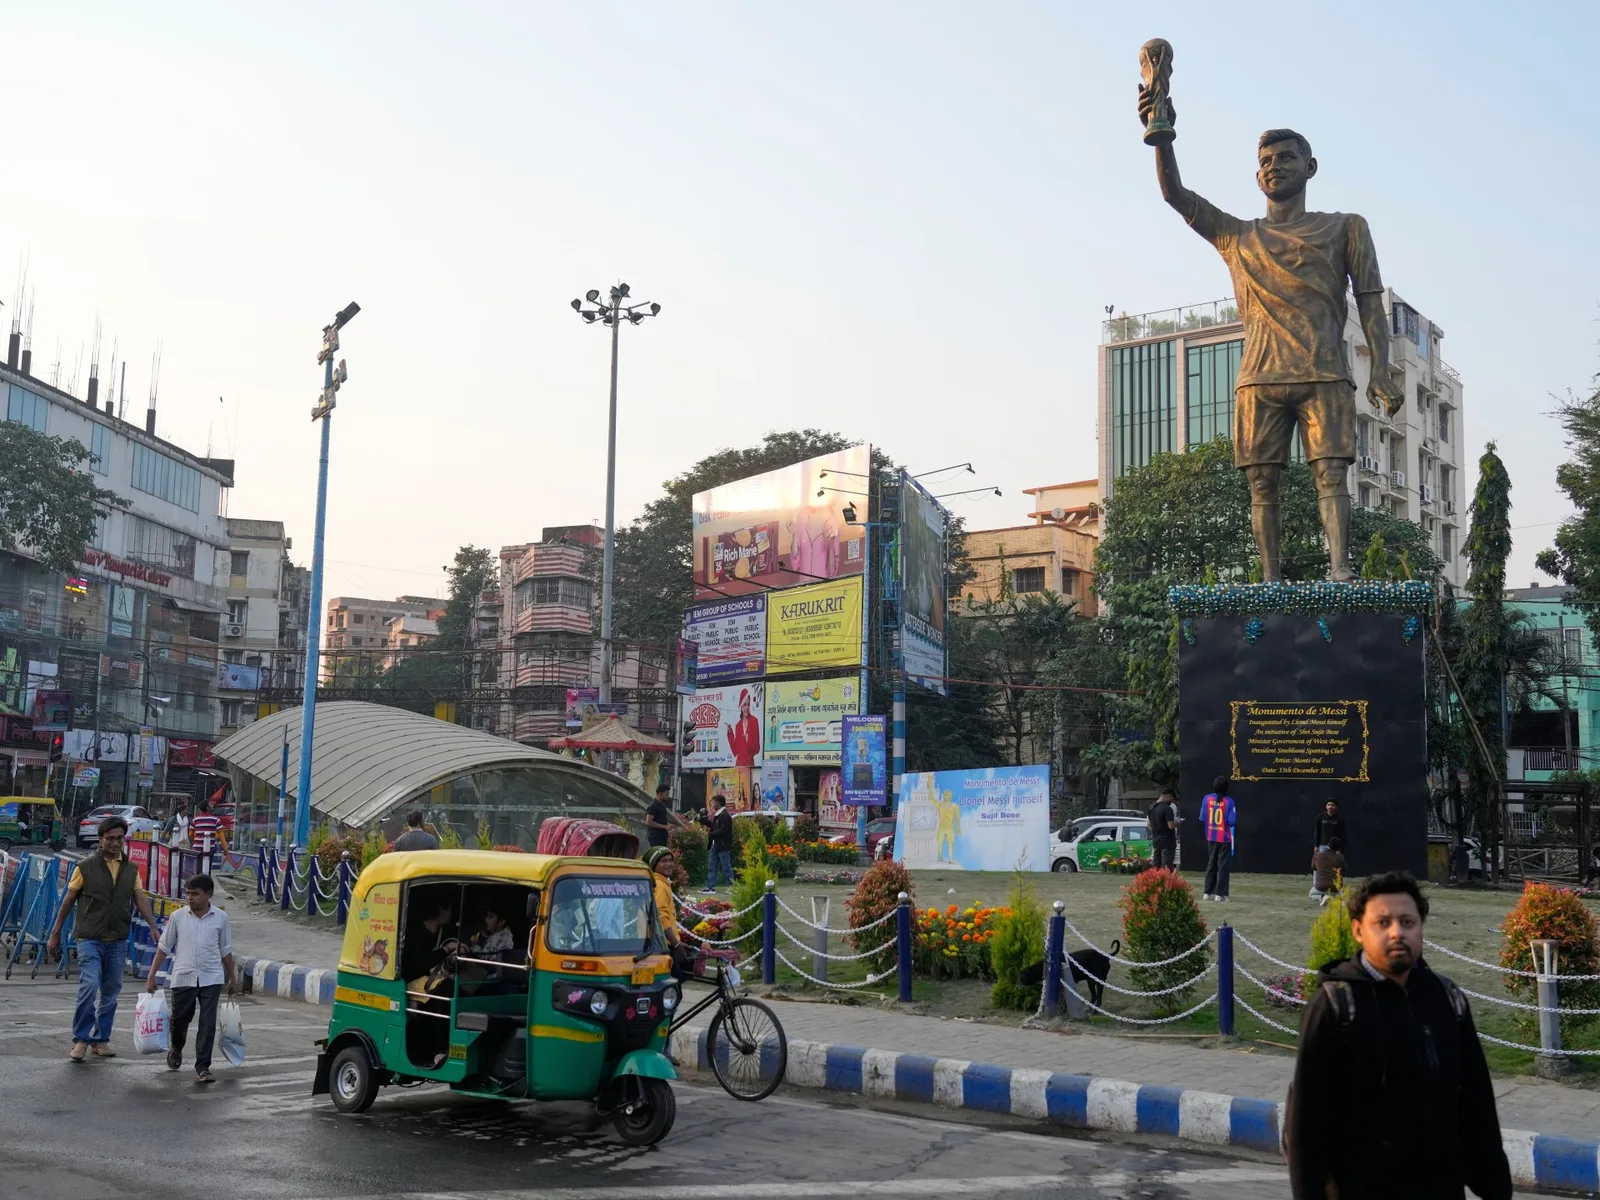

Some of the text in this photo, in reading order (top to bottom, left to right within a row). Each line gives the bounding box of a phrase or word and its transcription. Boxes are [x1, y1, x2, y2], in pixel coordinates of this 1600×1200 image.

[724, 544, 758, 562] Rich Marie
[702, 606, 720, 616] GROUP
[720, 604, 728, 612] OF
[728, 600, 754, 612] SCHOOLS
[780, 596, 846, 620] KARUKRIT
[1247, 706, 1347, 716] Monumento de Messi
[964, 776, 1040, 788] Monumento de Messi
[960, 793, 1043, 806] Lionel Messi himself
[1209, 808, 1223, 825] 10
[141, 1018, 163, 1035] SALE
